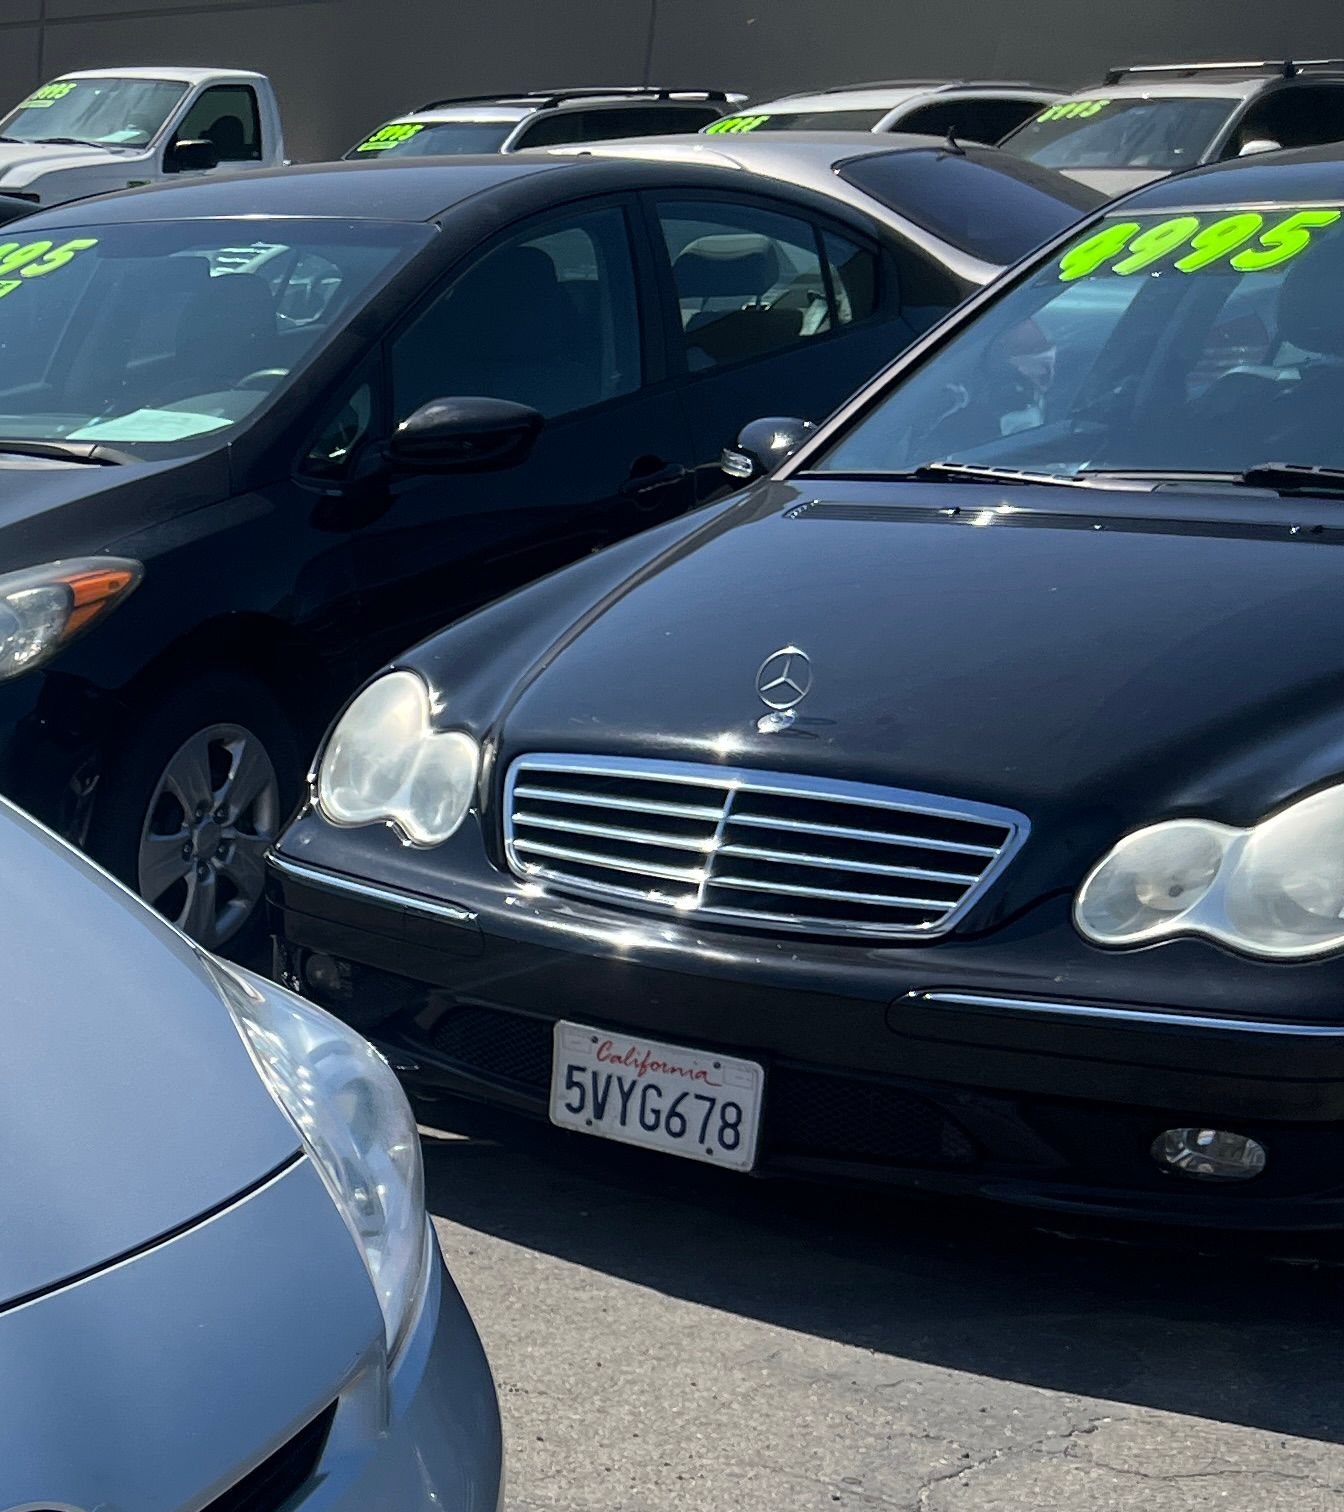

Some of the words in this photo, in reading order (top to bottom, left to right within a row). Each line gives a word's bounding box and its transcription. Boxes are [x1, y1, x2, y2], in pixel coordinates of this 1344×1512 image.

[1058, 210, 1342, 282] 4995
[596, 1040, 722, 1087] California
[565, 1064, 743, 1151] 5VYG678
